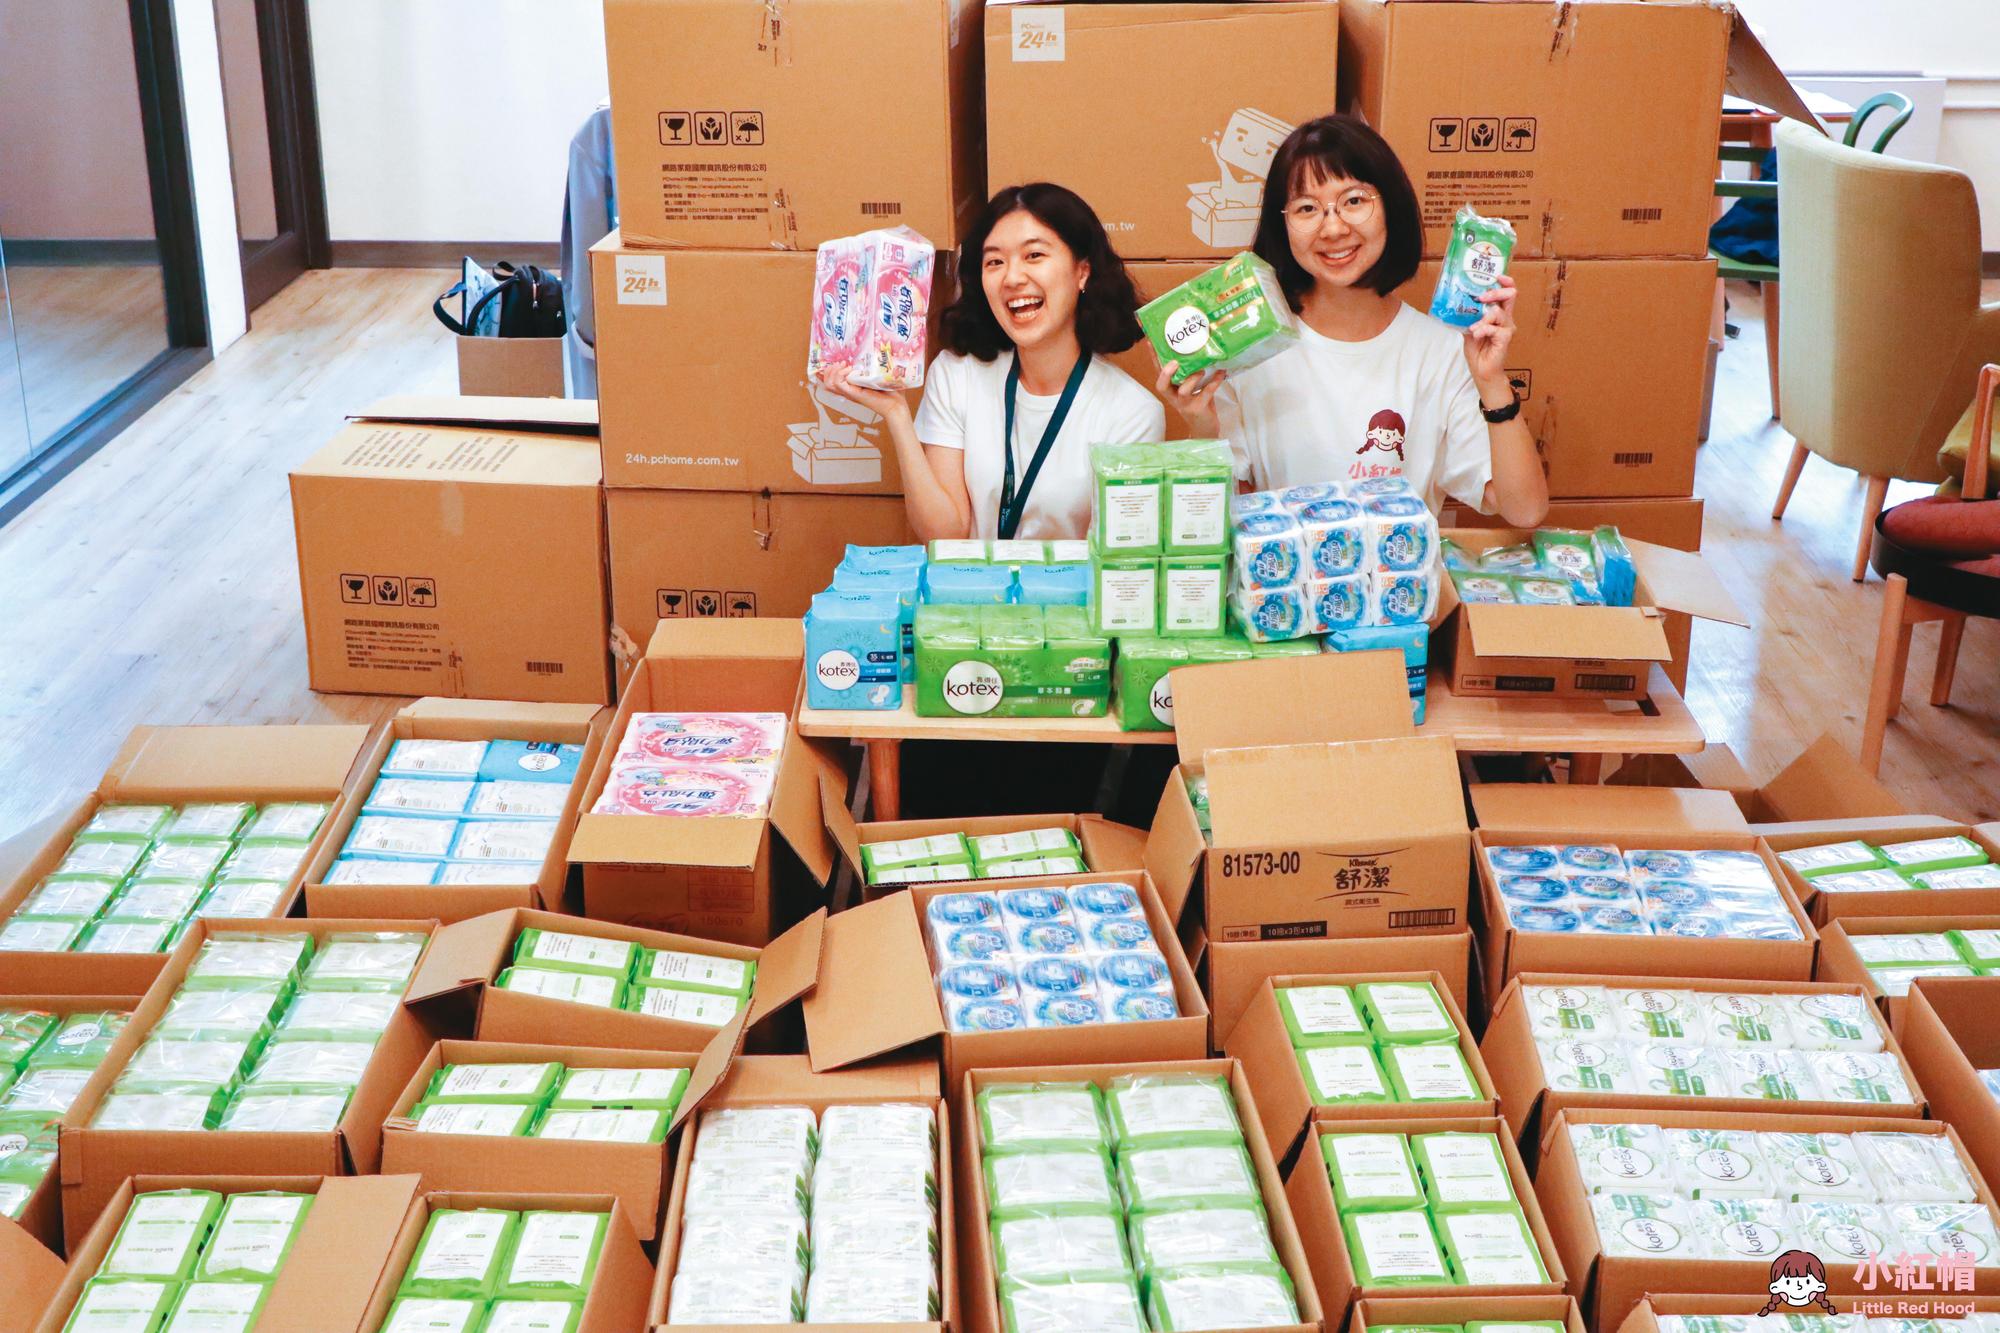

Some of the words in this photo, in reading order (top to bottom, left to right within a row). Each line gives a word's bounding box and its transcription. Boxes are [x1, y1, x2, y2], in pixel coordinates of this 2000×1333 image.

[1166, 318, 1207, 346] kotex
[625, 453, 739, 467] 24h.pchome.com.tw
[818, 663, 857, 677] kotex
[947, 679, 998, 697] kotex
[1223, 851, 1301, 877] 81573-00
[1334, 866, 1390, 890] 舒潔
[1743, 1223, 1764, 1253] kotex
